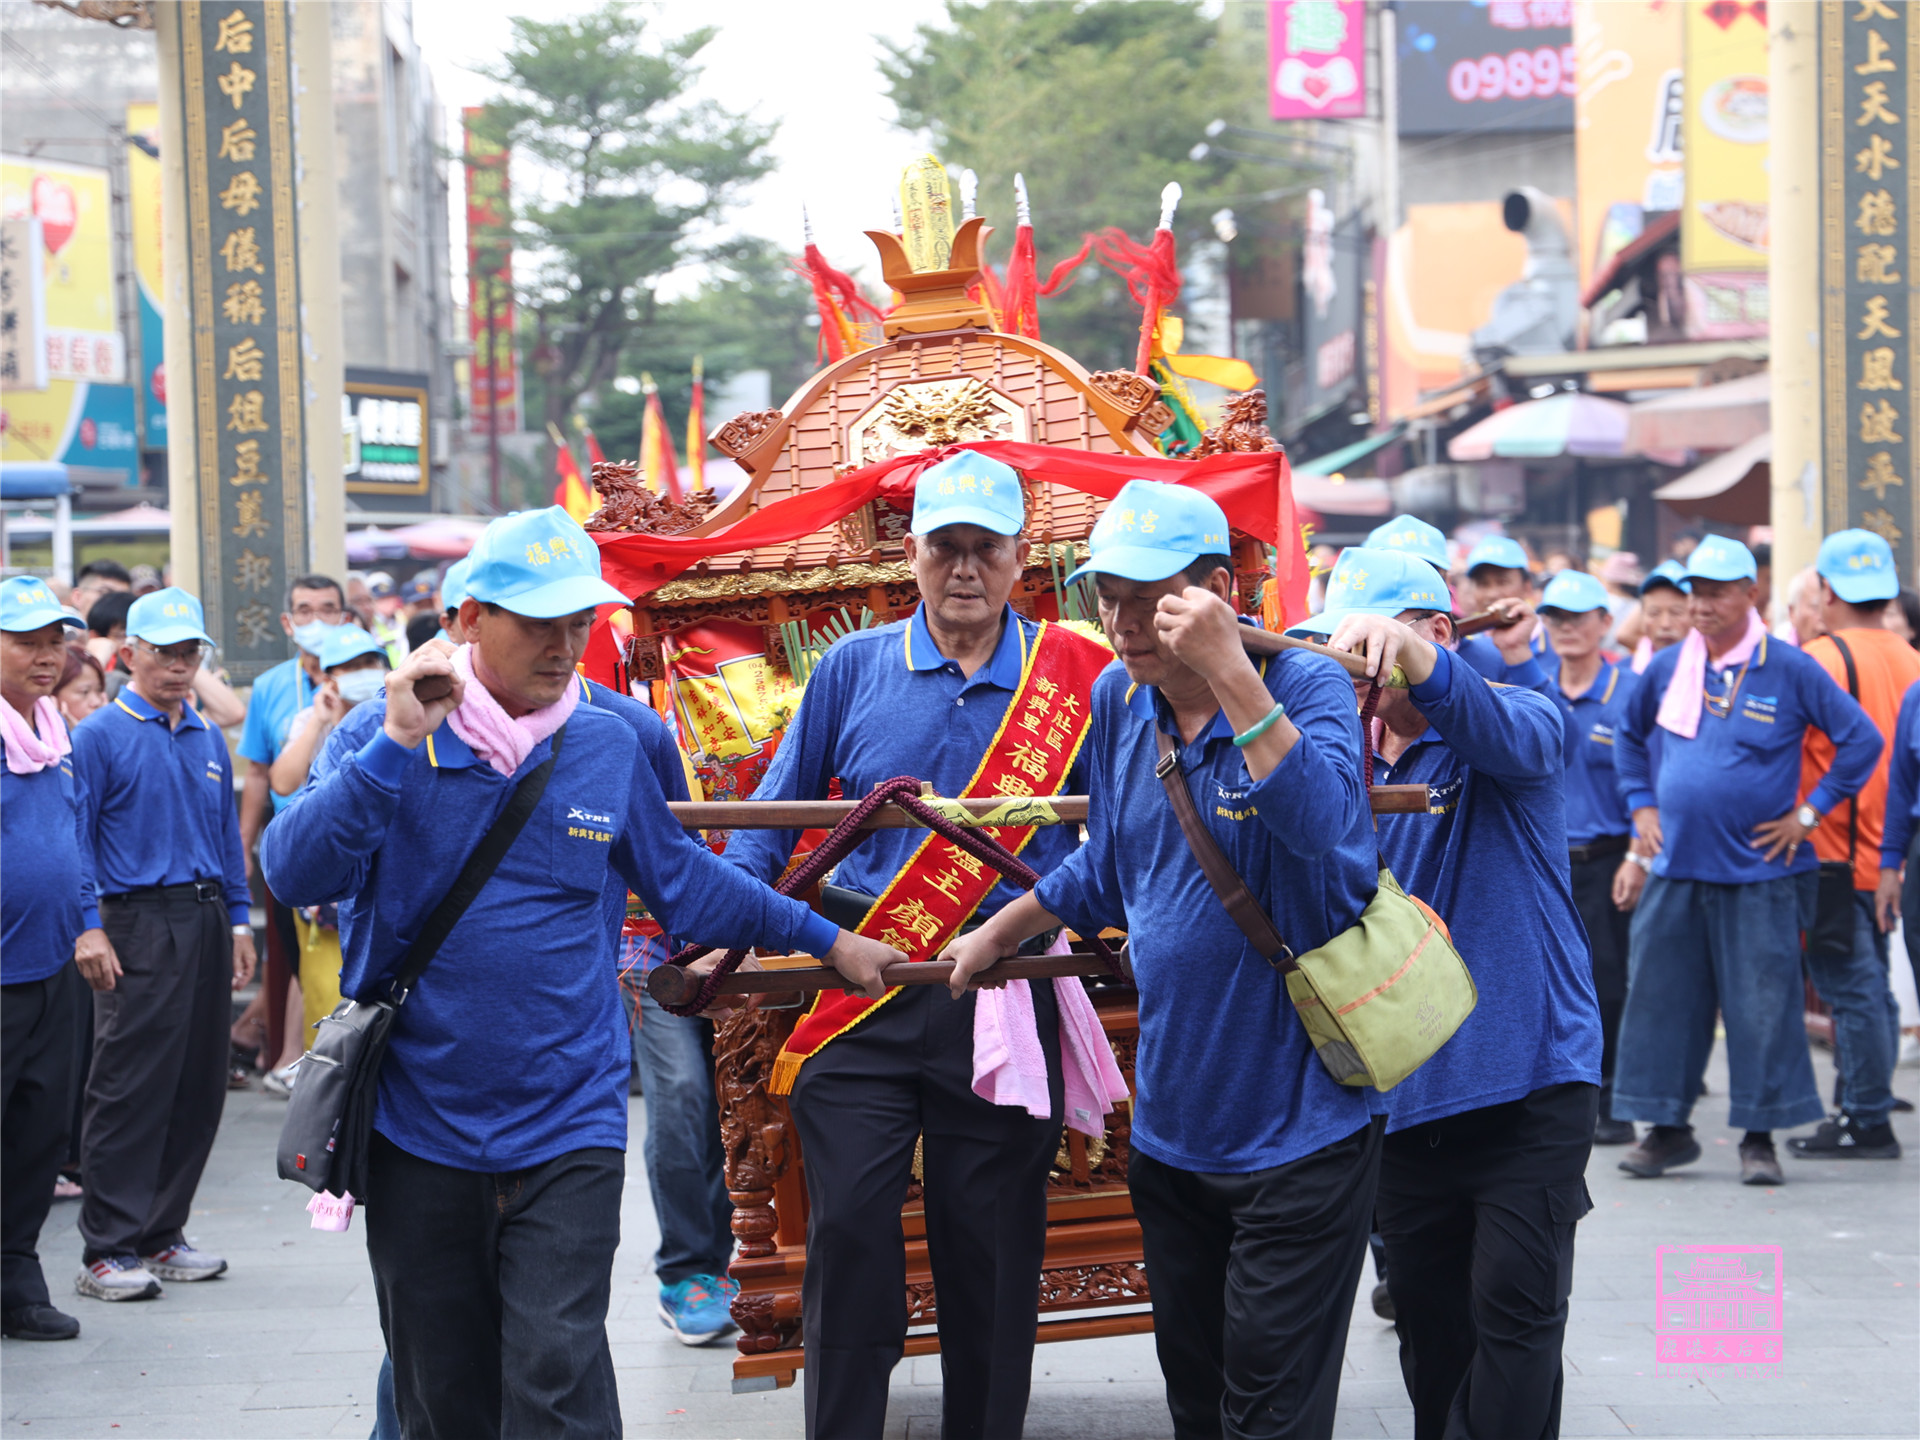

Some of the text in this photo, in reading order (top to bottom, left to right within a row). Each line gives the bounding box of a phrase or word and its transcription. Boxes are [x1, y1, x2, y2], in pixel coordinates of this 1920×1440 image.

[936, 474, 996, 497] 福興宮
[878, 512, 910, 539] 宮
[688, 689, 722, 754] 吉祥如意
[703, 682, 738, 741] 合境平安
[1017, 676, 1059, 736] 新興里
[1044, 693, 1081, 754] 大肚區
